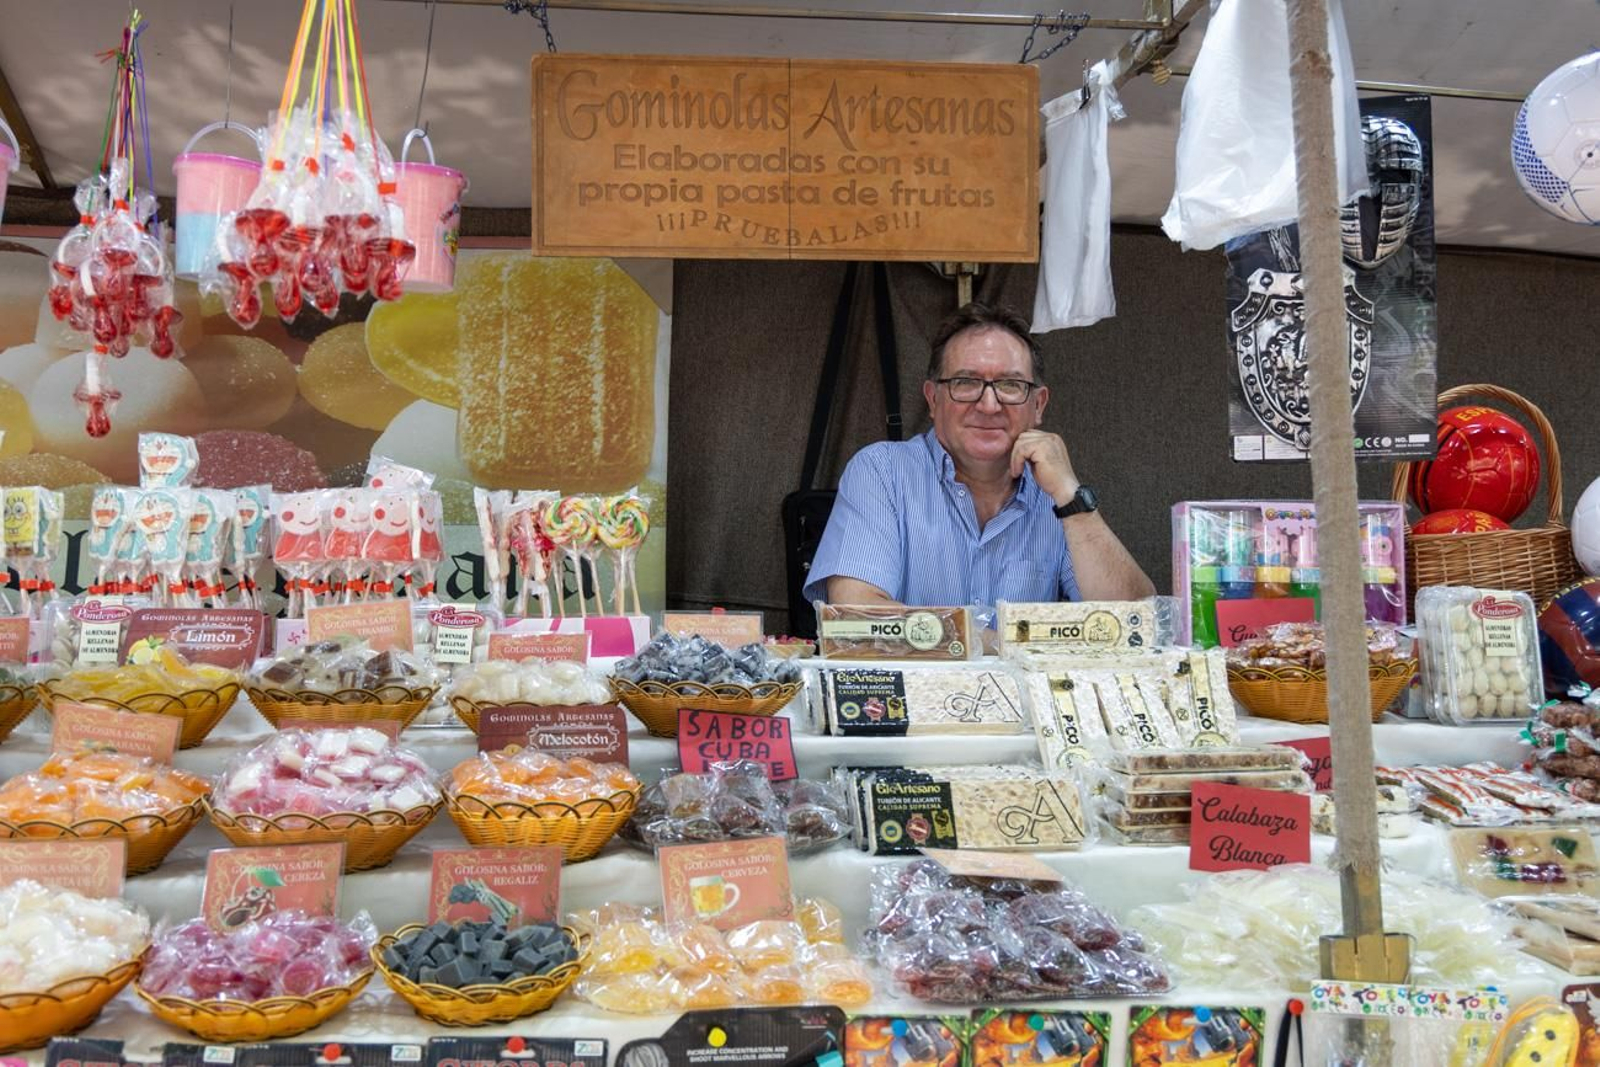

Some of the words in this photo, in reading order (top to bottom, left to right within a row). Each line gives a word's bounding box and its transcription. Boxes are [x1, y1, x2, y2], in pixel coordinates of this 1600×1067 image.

[557, 70, 790, 141] Gominolas
[803, 79, 1015, 151] Artesanas
[613, 143, 826, 173] Elaboradas
[837, 154, 901, 174] con
[913, 156, 950, 176] su
[578, 177, 703, 207] propia
[716, 179, 820, 208] pasta
[832, 179, 879, 206] de
[889, 179, 996, 208] frutas
[77, 607, 128, 621] Ponderosa
[1477, 603, 1519, 616] Ponderosa
[433, 611, 482, 625] Ponderosa
[185, 629, 237, 643] Limón
[687, 709, 783, 739] SABOR
[538, 731, 610, 747] Melocotón
[699, 741, 771, 761] CUBA
[896, 783, 941, 794] Artesano
[1197, 796, 1298, 836] Calabaza
[1208, 834, 1287, 866] Blanca
[454, 864, 508, 876] GOLOSINA
[683, 857, 737, 871] GOLOSINA
[720, 865, 769, 878] CERVEZA
[493, 874, 540, 886] REGALIZ
[719, 1046, 773, 1055] CONCENTRATION
